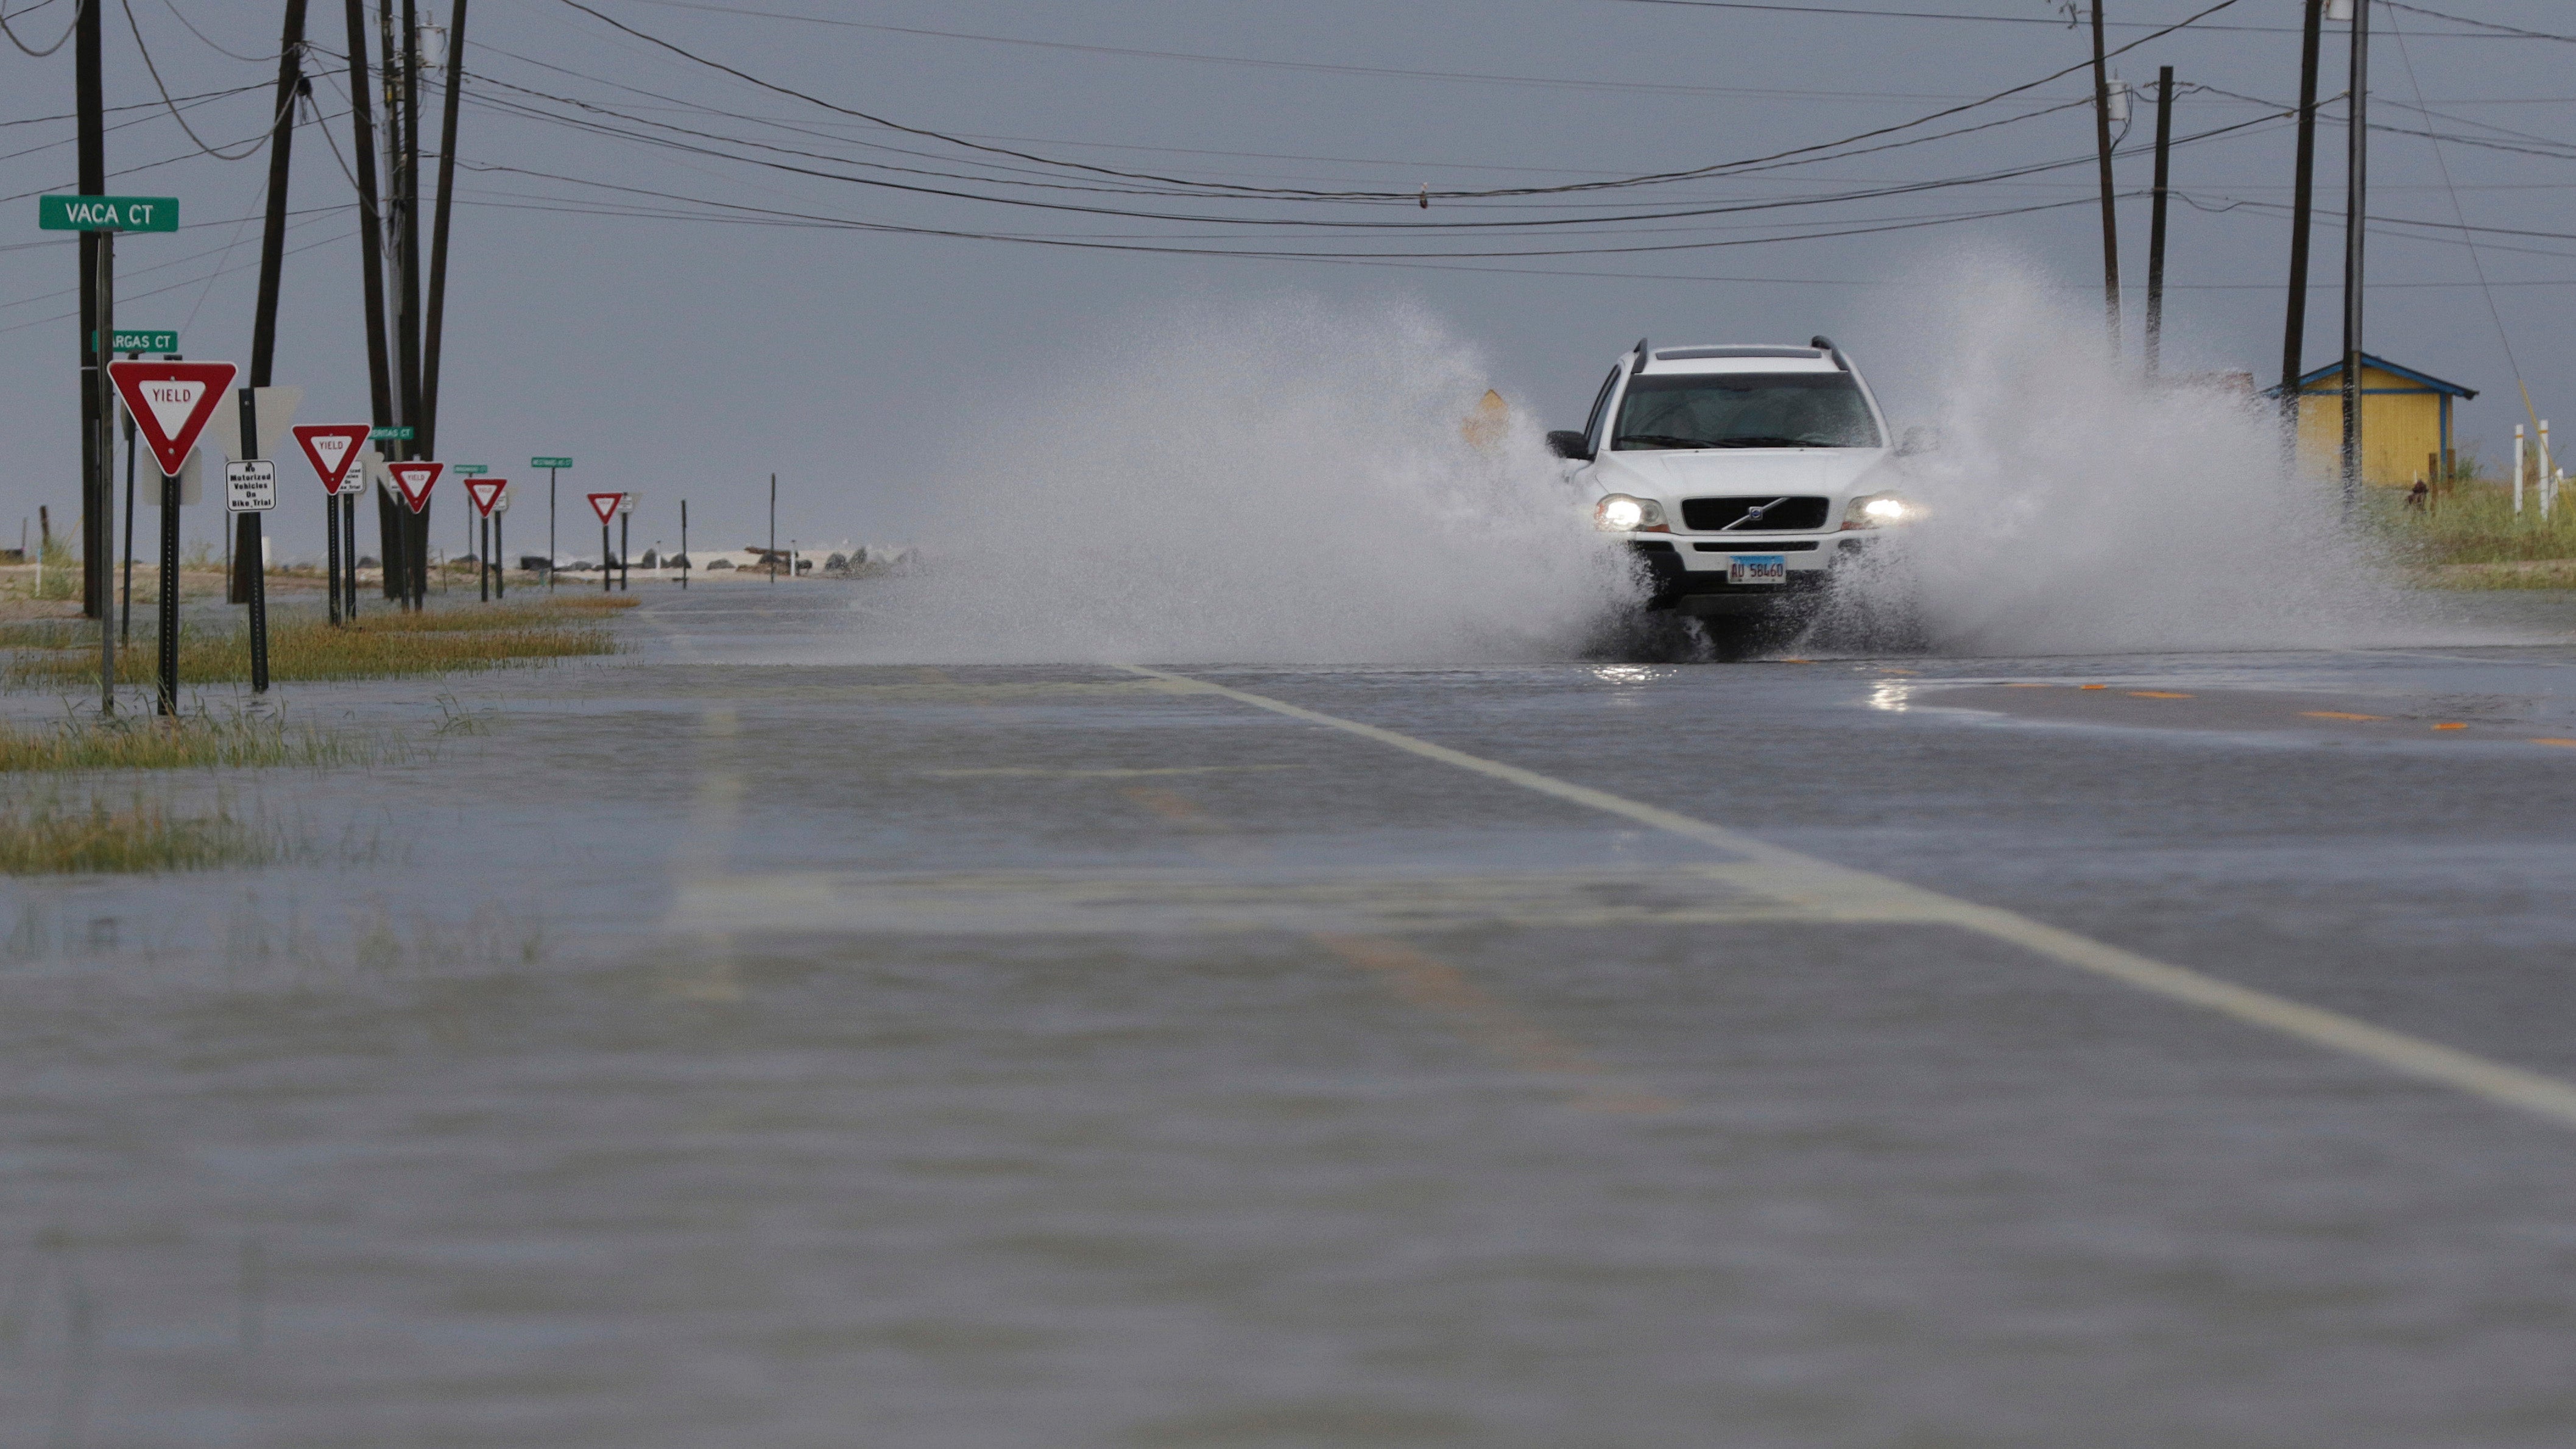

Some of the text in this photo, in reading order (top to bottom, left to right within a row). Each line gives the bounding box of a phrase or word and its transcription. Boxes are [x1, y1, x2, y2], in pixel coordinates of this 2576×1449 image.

[65, 203, 154, 224] VACA CT
[155, 336, 170, 348] CT
[152, 389, 191, 402] YIELD
[400, 429, 410, 437] CT
[320, 441, 343, 450] YIELD
